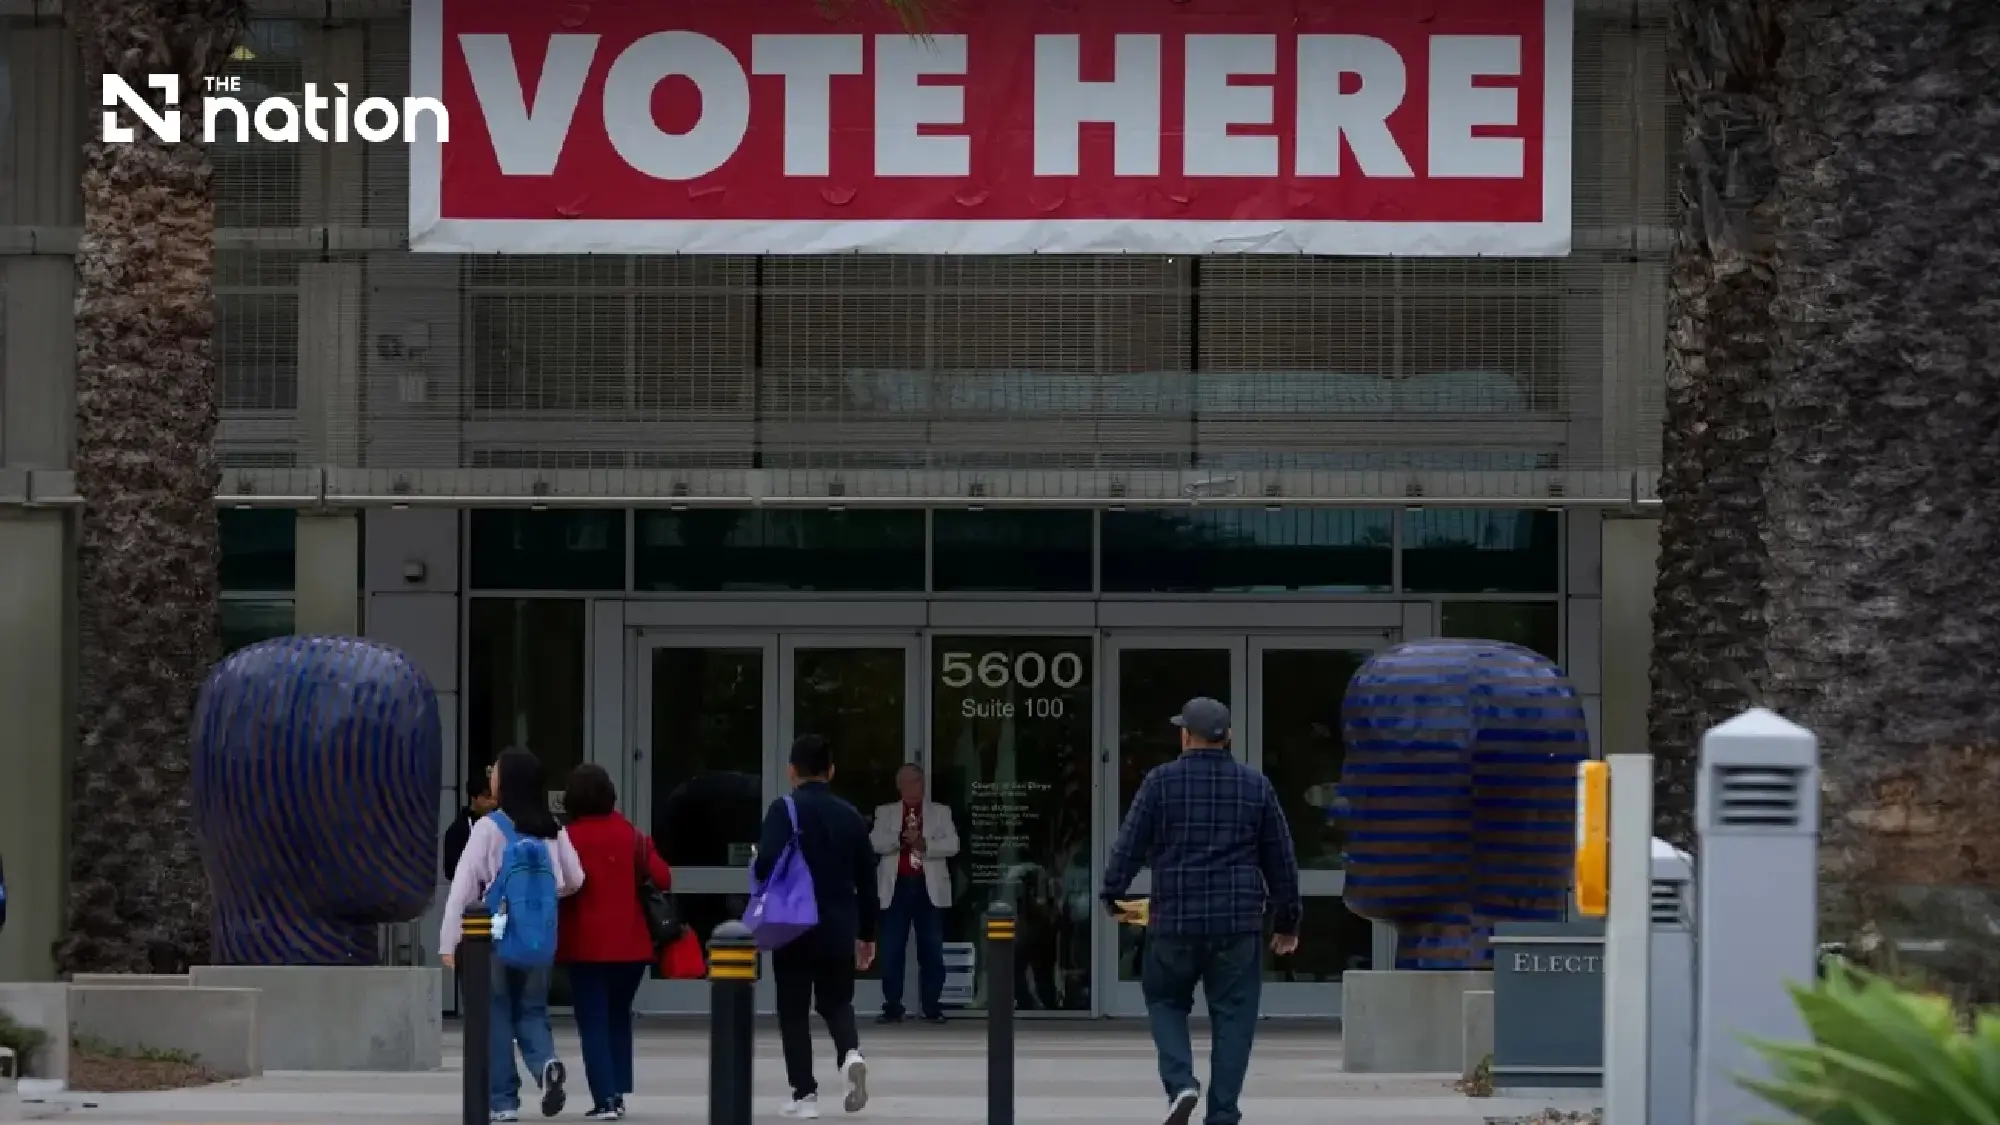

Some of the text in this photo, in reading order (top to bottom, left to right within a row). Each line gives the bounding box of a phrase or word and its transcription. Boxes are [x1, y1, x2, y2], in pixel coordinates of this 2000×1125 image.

[458, 31, 1526, 180] VOTE HERE
[942, 652, 1082, 688] 5600
[961, 697, 1064, 718] Suite 100
